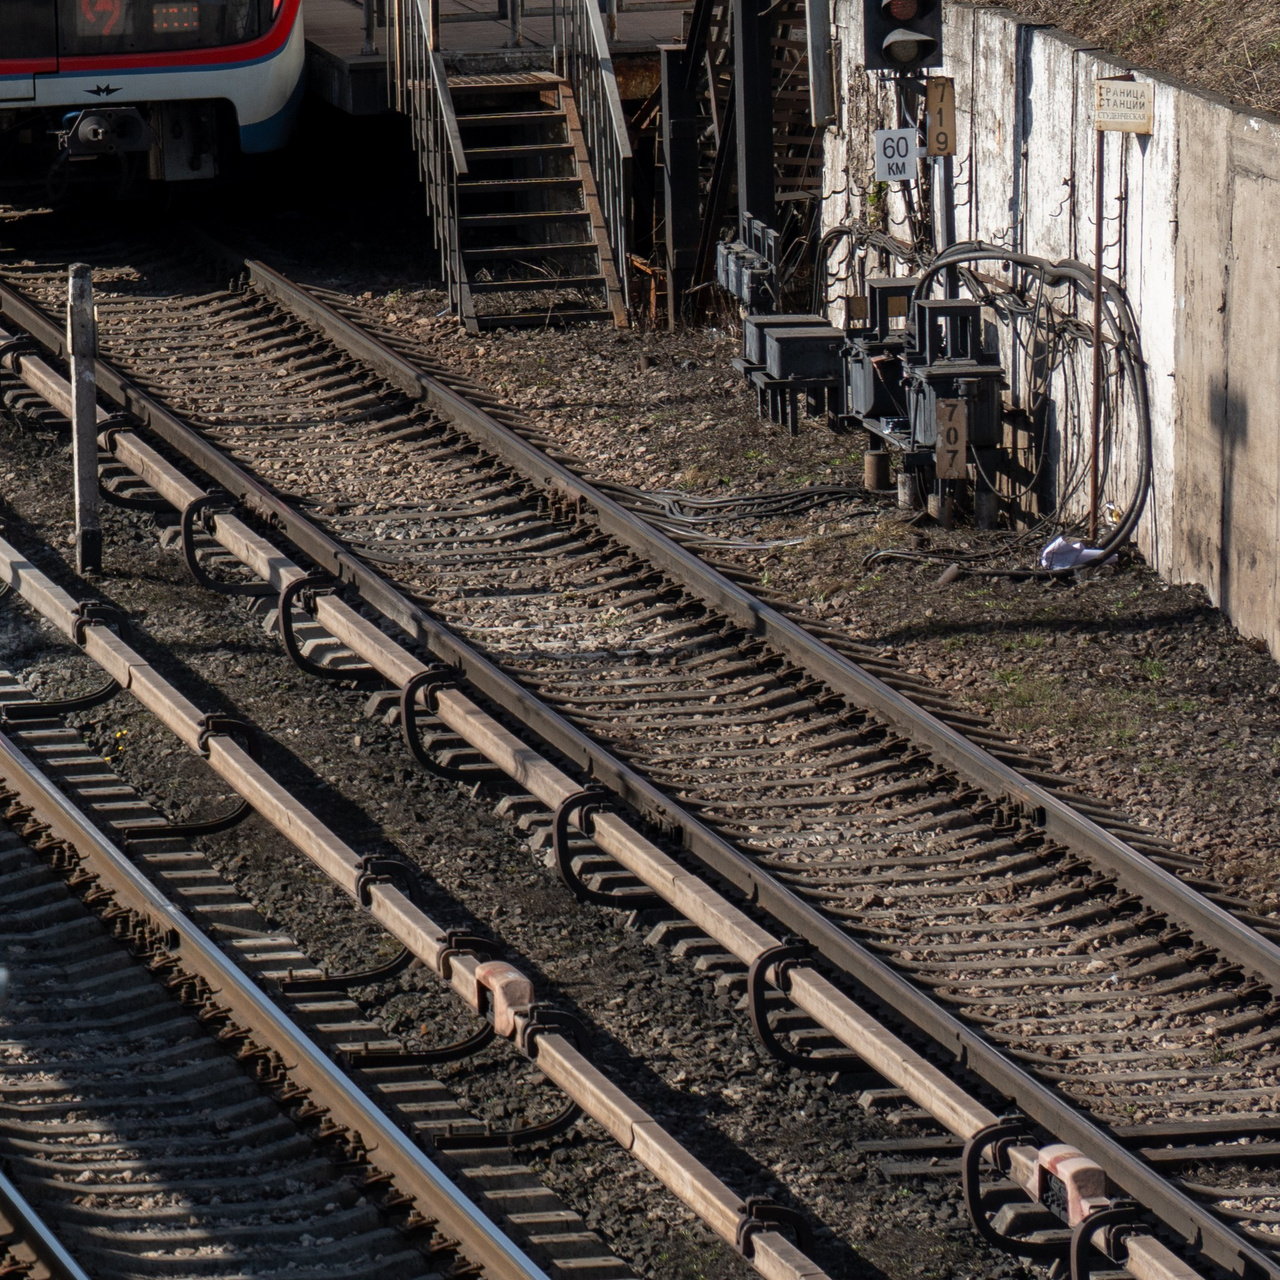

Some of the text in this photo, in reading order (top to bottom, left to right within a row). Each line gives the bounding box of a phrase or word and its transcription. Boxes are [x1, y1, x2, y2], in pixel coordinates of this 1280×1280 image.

[1099, 85, 1146, 100] ГРАНИЦА
[1099, 98, 1145, 110] СТАНЦИИ
[934, 82, 949, 152] 719
[1097, 111, 1146, 121] СТУДЕНЧЕСКАЯ
[883, 136, 909, 159] 60
[887, 162, 906, 176] КМ
[945, 403, 959, 468] 707
